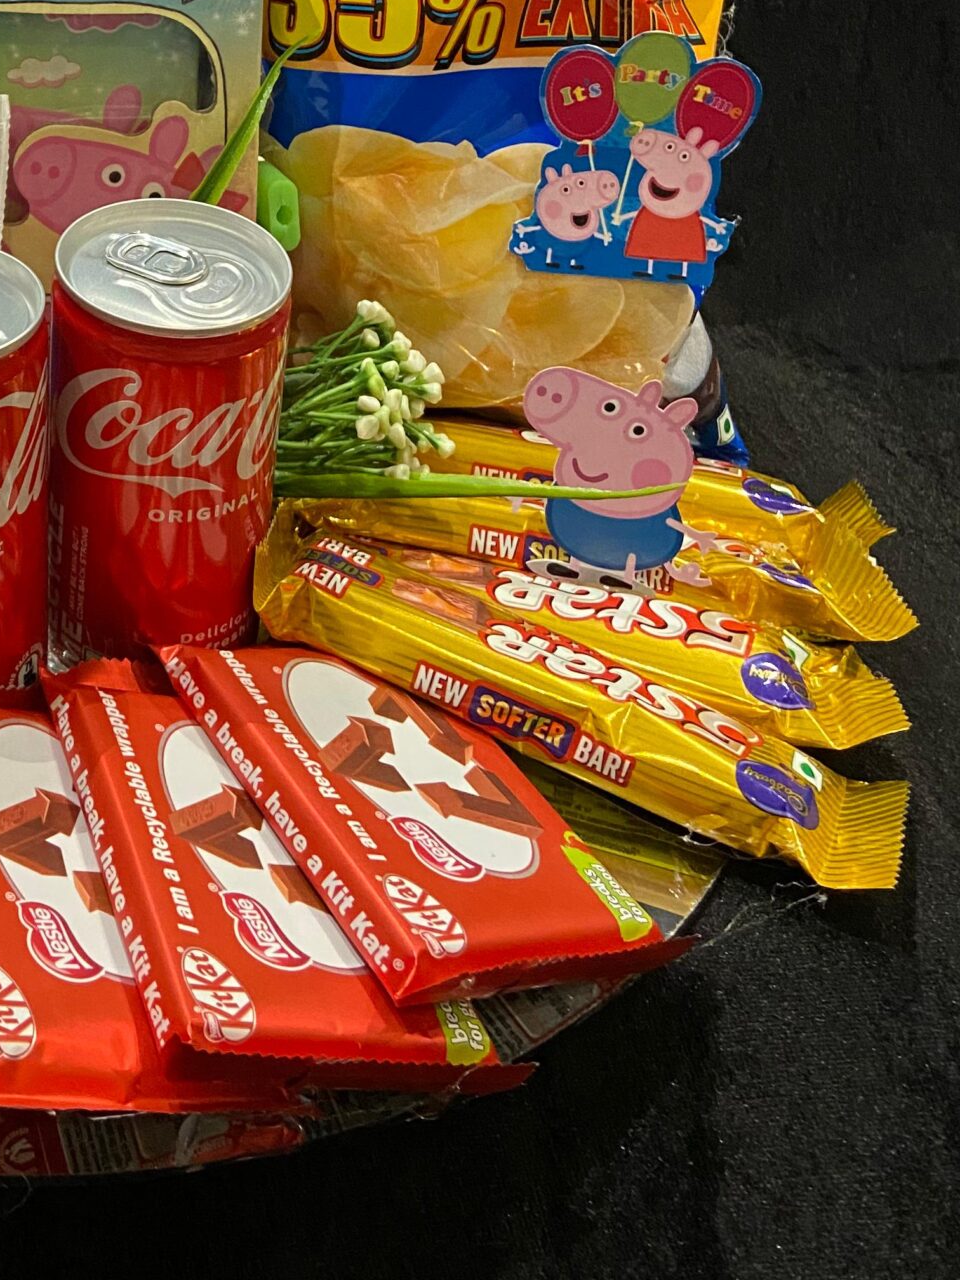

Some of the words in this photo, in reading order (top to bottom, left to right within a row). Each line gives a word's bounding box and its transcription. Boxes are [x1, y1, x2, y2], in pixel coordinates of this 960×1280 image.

[559, 78, 603, 107] It's
[619, 63, 688, 93] Party
[692, 83, 744, 120] Time
[147, 487, 259, 524] ORIGINAL
[316, 536, 373, 566] BAR!
[470, 526, 519, 560] NEW
[293, 561, 350, 595] NEW
[217, 649, 269, 707] wrappe
[49, 693, 76, 753] Have
[96, 687, 136, 757] wrapper
[412, 663, 470, 708] NEW
[475, 693, 568, 750] SOFTER
[572, 734, 633, 784] BAR!
[70, 753, 80, 771] a
[263, 707, 342, 801] Recyclable
[76, 769, 105, 851] break,
[127, 759, 174, 864] Recyclable
[164, 656, 206, 709] Have
[203, 708, 219, 728] a
[214, 721, 265, 799] break,
[264, 789, 308, 854] have
[305, 853, 324, 877] a
[319, 869, 356, 916] Kit
[348, 911, 390, 974] Kat.
[334, 803, 353, 817] a
[743, 764, 810, 818] Cadbury
[346, 819, 379, 852] am
[100, 844, 127, 913] have
[162, 866, 181, 881] a
[582, 867, 634, 922] breaks
[121, 915, 135, 937] a
[169, 886, 195, 921] am
[386, 875, 467, 949] KitKat
[623, 899, 649, 925] for
[127, 933, 153, 981] Kit
[143, 980, 171, 1050] Kat.
[186, 952, 254, 1029] KitKat
[466, 1021, 485, 1051] for
